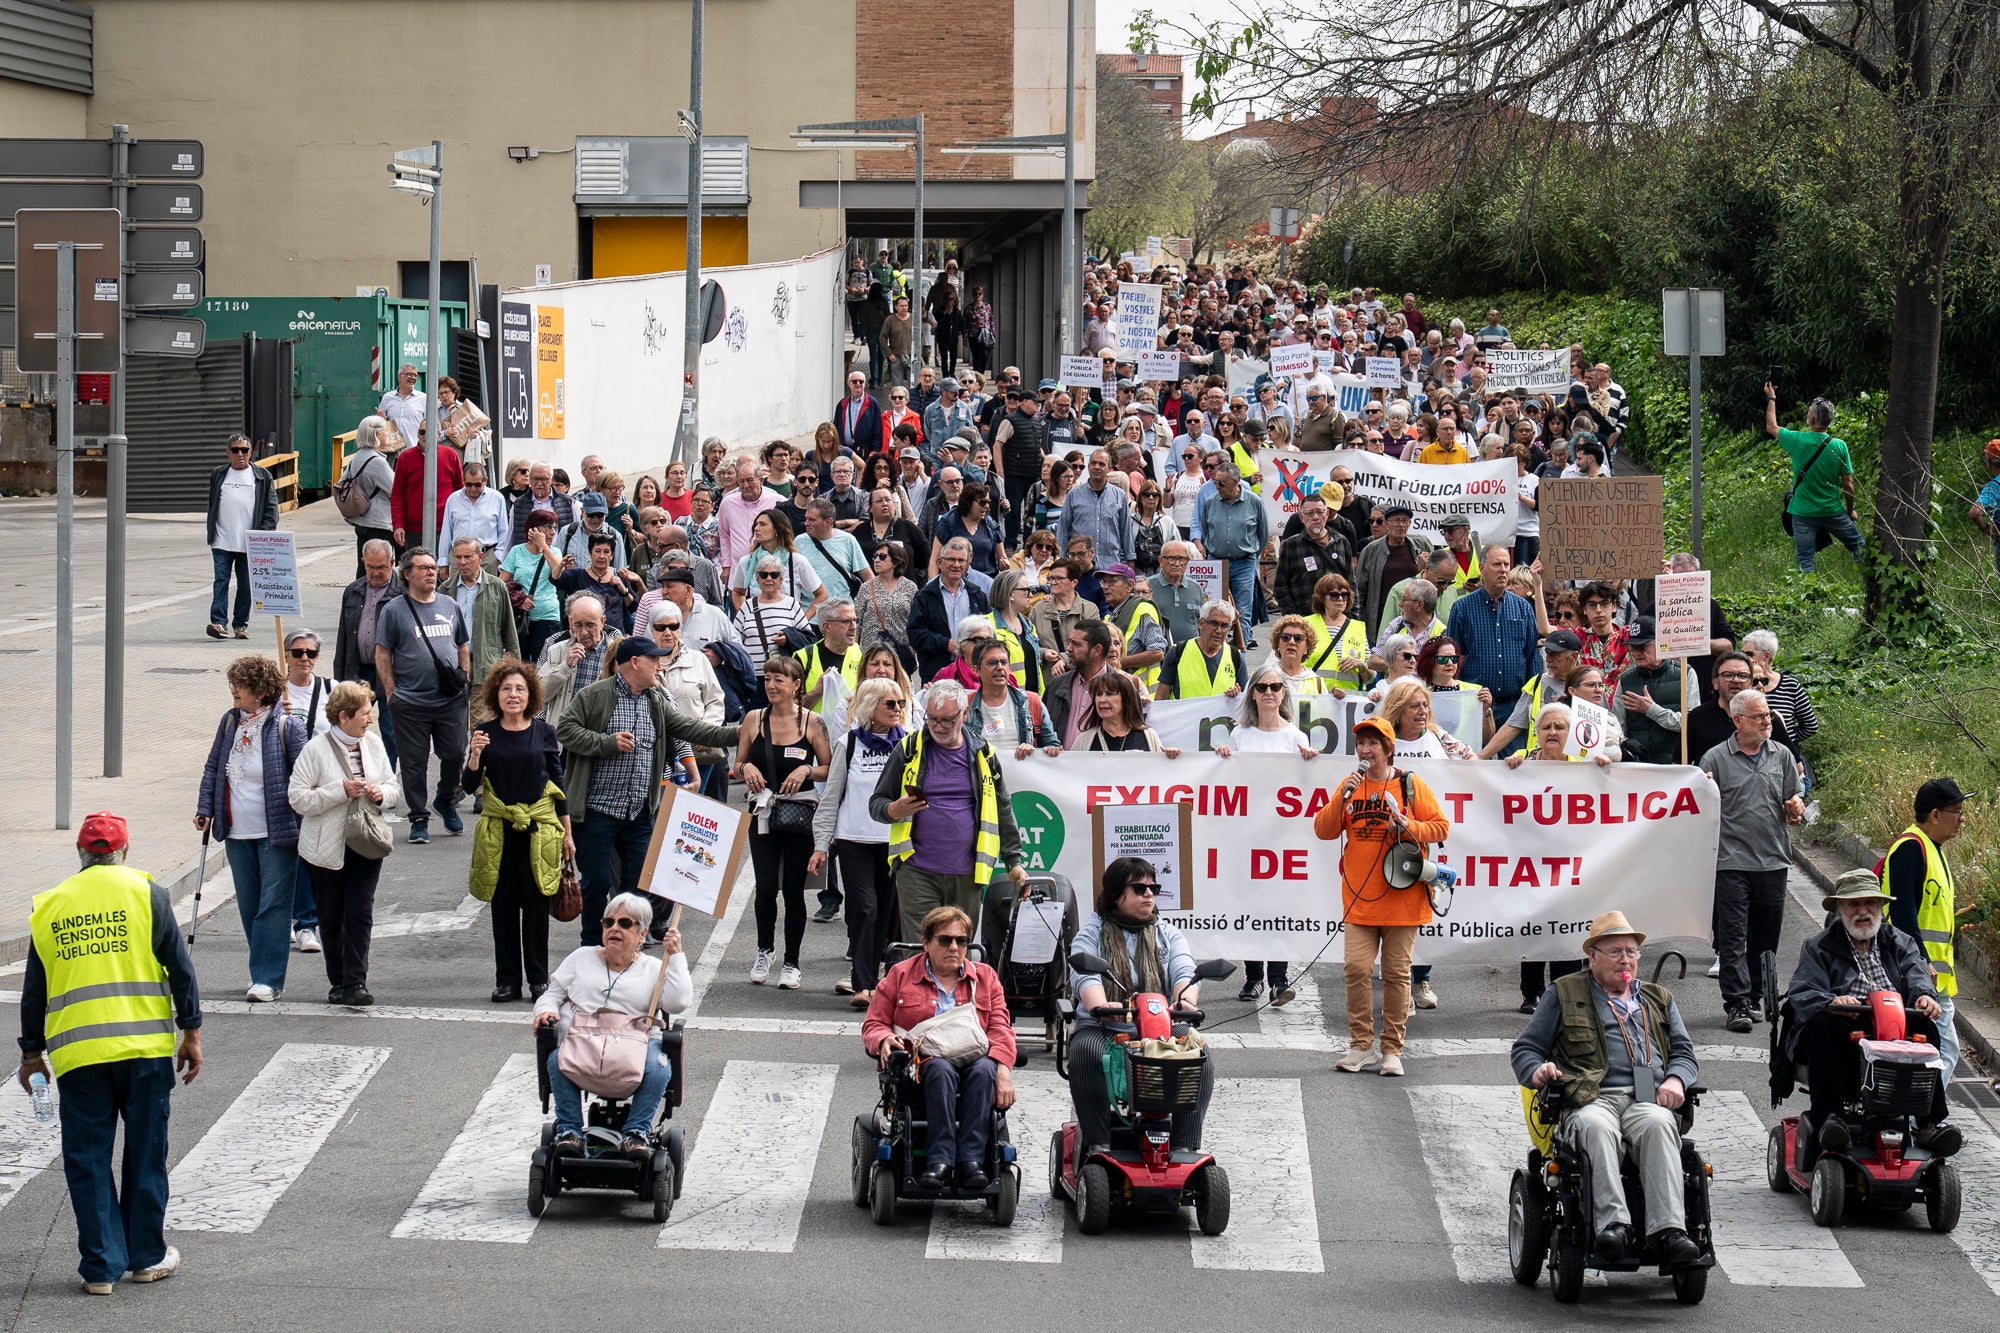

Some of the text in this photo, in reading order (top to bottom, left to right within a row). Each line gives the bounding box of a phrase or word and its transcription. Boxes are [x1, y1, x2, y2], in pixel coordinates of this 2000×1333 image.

[206, 301, 250, 311] 17180
[1125, 303, 1155, 314] VOSTRES
[1120, 314, 1143, 324] URPES
[1128, 327, 1156, 337] NOSTRA
[1120, 338, 1153, 350] SANITAT
[1272, 354, 1290, 364] Olga
[1275, 361, 1308, 372] DIMISSIÓ
[1354, 472, 1506, 495] NITAT PÚBLICA 100%
[1544, 482, 1604, 501] MIENTRAS
[1431, 503, 1446, 514] EN
[1450, 503, 1505, 514] DEFENSA
[1547, 504, 1562, 526] SE
[1547, 527, 1564, 546] CON
[1601, 529, 1608, 546] Y
[251, 557, 276, 565] Urgent!
[1549, 548, 1564, 564] AL
[1566, 549, 1596, 565] RESTO
[1600, 549, 1617, 568] NOS
[252, 567, 270, 575] 25%
[1190, 566, 1213, 574] PROU
[1555, 565, 1570, 579] EN
[1574, 566, 1587, 578] EL
[1659, 598, 1666, 606] la
[1659, 607, 1692, 621] pública
[1662, 625, 1704, 635] de Qualitat
[1578, 704, 1586, 712] NO
[1578, 711, 1601, 725] GUERRA
[1086, 785, 1248, 817] EXIGIM
[1502, 786, 1700, 825] PÚBLICA
[687, 812, 718, 832] VOLEM
[681, 822, 718, 842] ESPECIALISTES
[1115, 824, 1170, 834] REHABILITACIÓ
[1208, 848, 1218, 879] I
[1250, 849, 1308, 880] DE
[51, 910, 127, 934] BLINDEM LES
[1162, 914, 1228, 932] omissió
[1450, 921, 1514, 938] Pública
[1520, 922, 1542, 935] de
